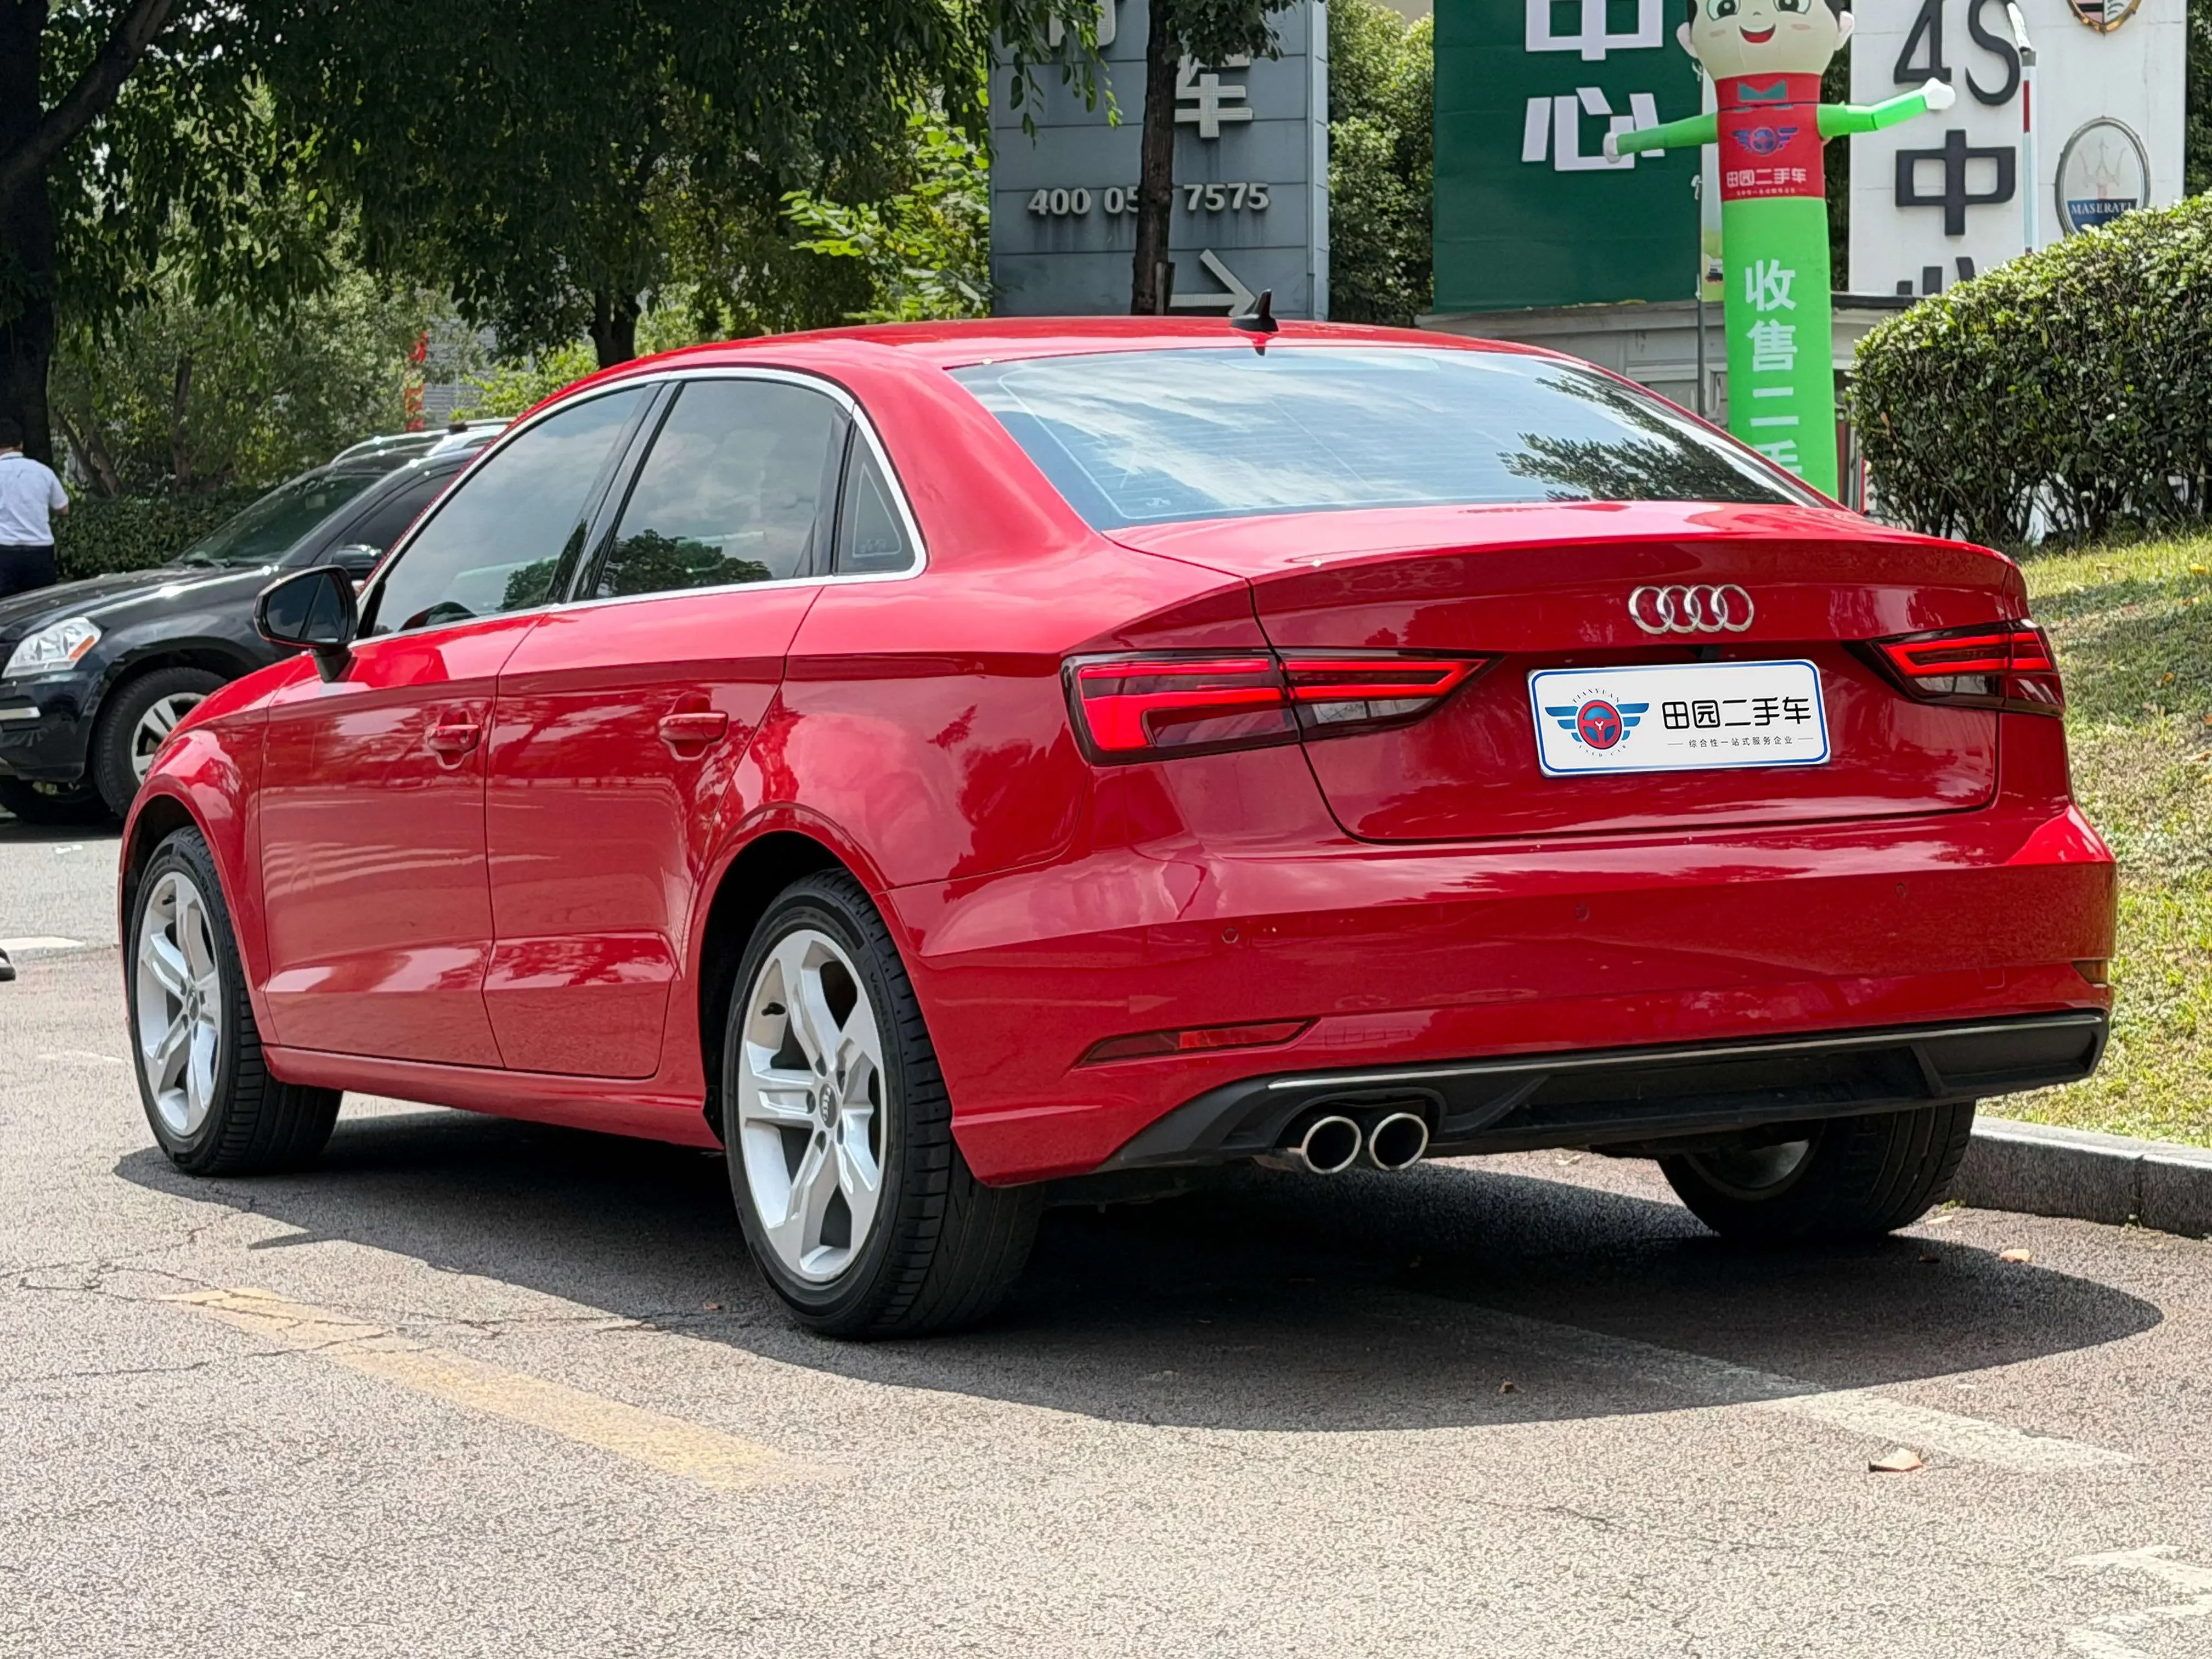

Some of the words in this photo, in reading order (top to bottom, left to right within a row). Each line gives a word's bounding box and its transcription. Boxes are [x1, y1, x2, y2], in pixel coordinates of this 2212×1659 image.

[1893, 0, 2021, 106] 4S
[1028, 187, 1092, 216] 400
[1103, 186, 1139, 214] 05
[1183, 182, 1270, 211] 7575
[1661, 696, 1812, 730] 田园二手车
[1688, 736, 1793, 748] 综合性一站式服务企业
